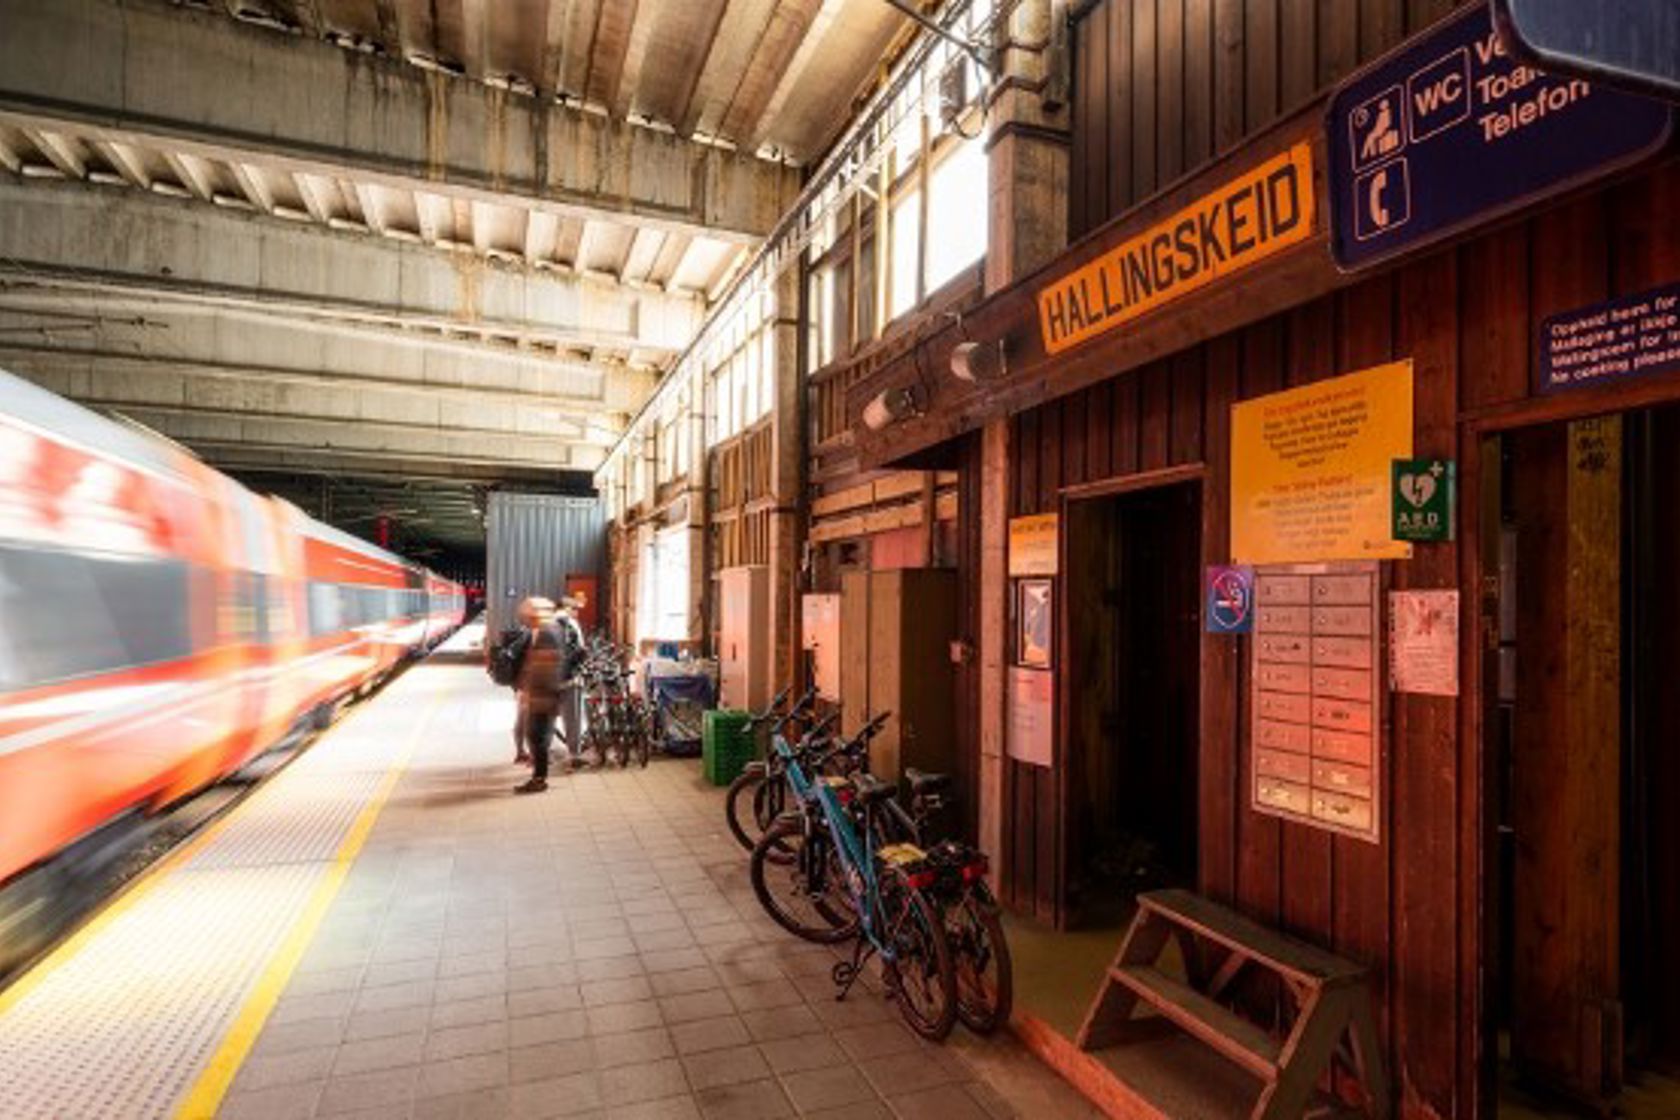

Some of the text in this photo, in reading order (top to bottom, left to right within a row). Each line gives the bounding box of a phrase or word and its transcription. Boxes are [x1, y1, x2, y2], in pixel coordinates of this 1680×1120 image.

[1415, 73, 1462, 117] WC
[1479, 79, 1591, 142] Telefon
[1048, 163, 1299, 343] HALLINGSKEID
[1655, 296, 1677, 311] for
[1641, 335, 1661, 349] for
